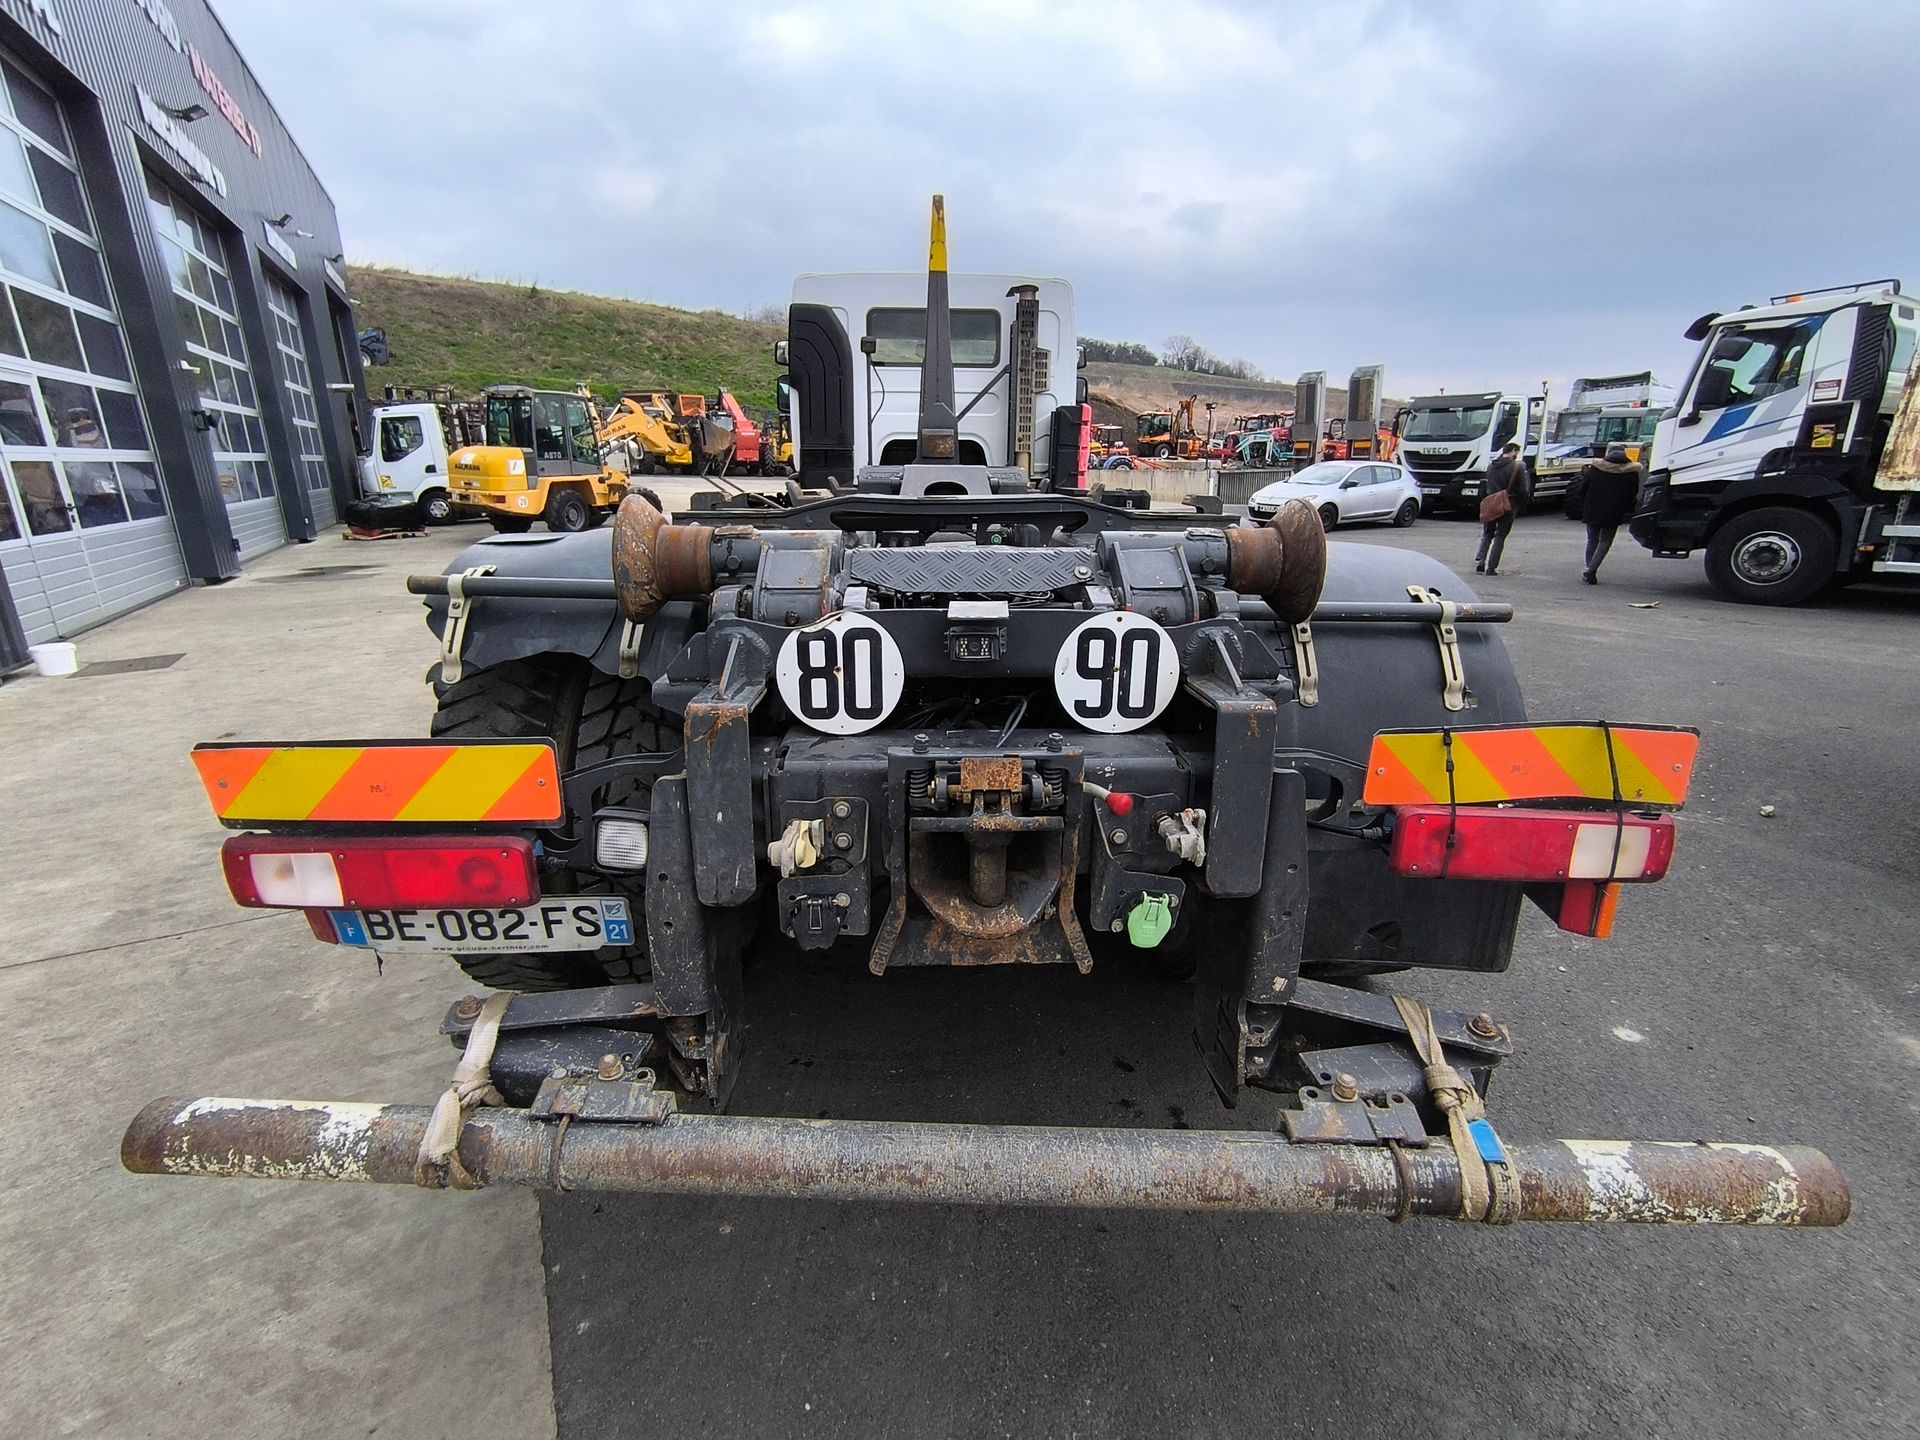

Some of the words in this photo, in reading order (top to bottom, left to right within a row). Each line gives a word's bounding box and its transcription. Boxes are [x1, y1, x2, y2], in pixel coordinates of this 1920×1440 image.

[797, 627, 883, 720] 80
[1074, 628, 1160, 718] 90
[347, 927, 355, 937] F
[362, 905, 602, 941] BE-082-FS
[609, 924, 628, 939] 21
